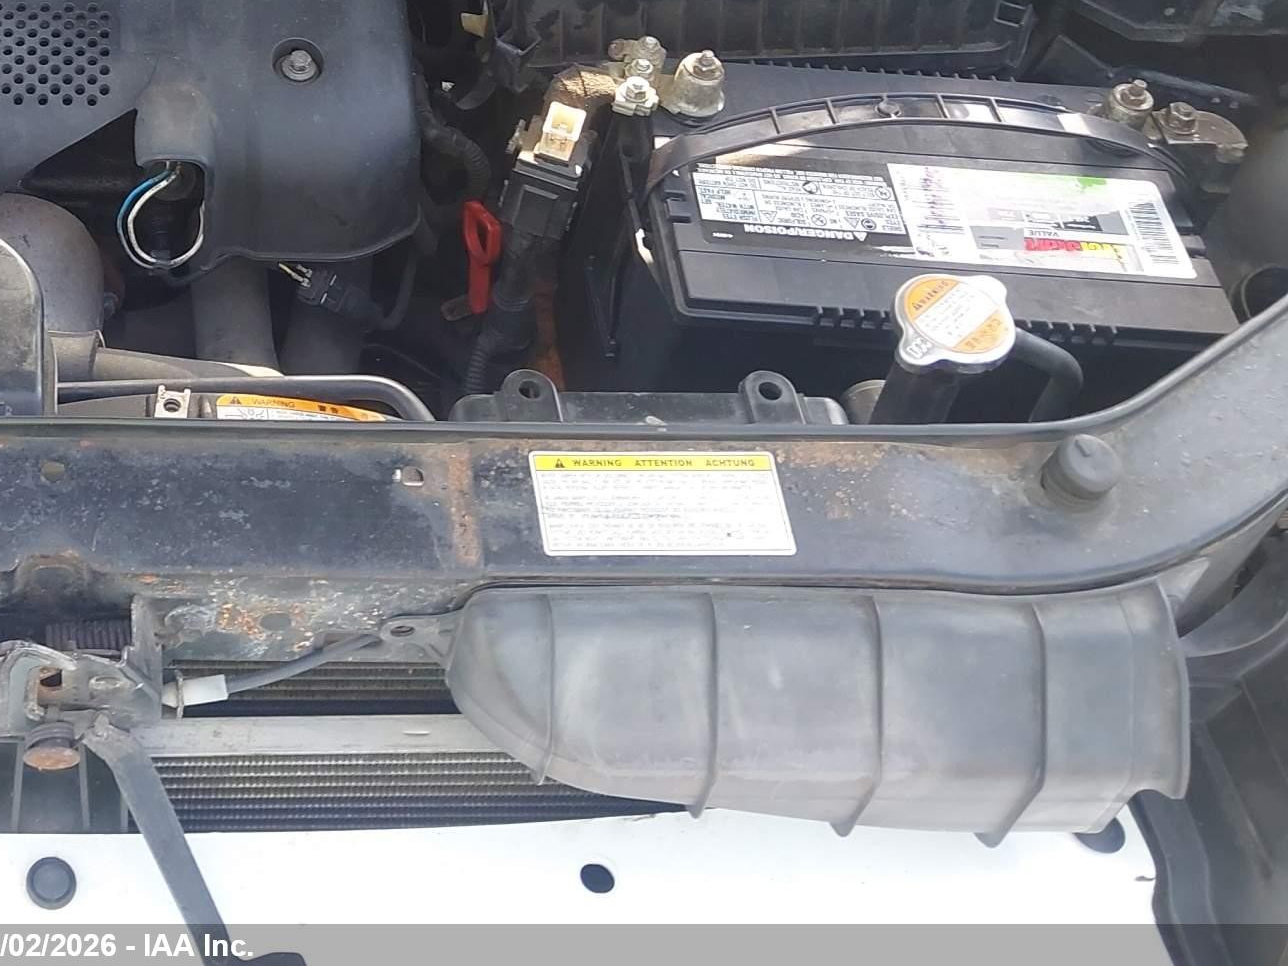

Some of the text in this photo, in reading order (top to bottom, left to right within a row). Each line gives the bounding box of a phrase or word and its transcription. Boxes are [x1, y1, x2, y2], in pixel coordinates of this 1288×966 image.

[742, 223, 854, 240] DANGER/POISON
[1027, 229, 1060, 238] VALUE
[573, 458, 756, 467] WARNING ATTENTION ACHTUNG
